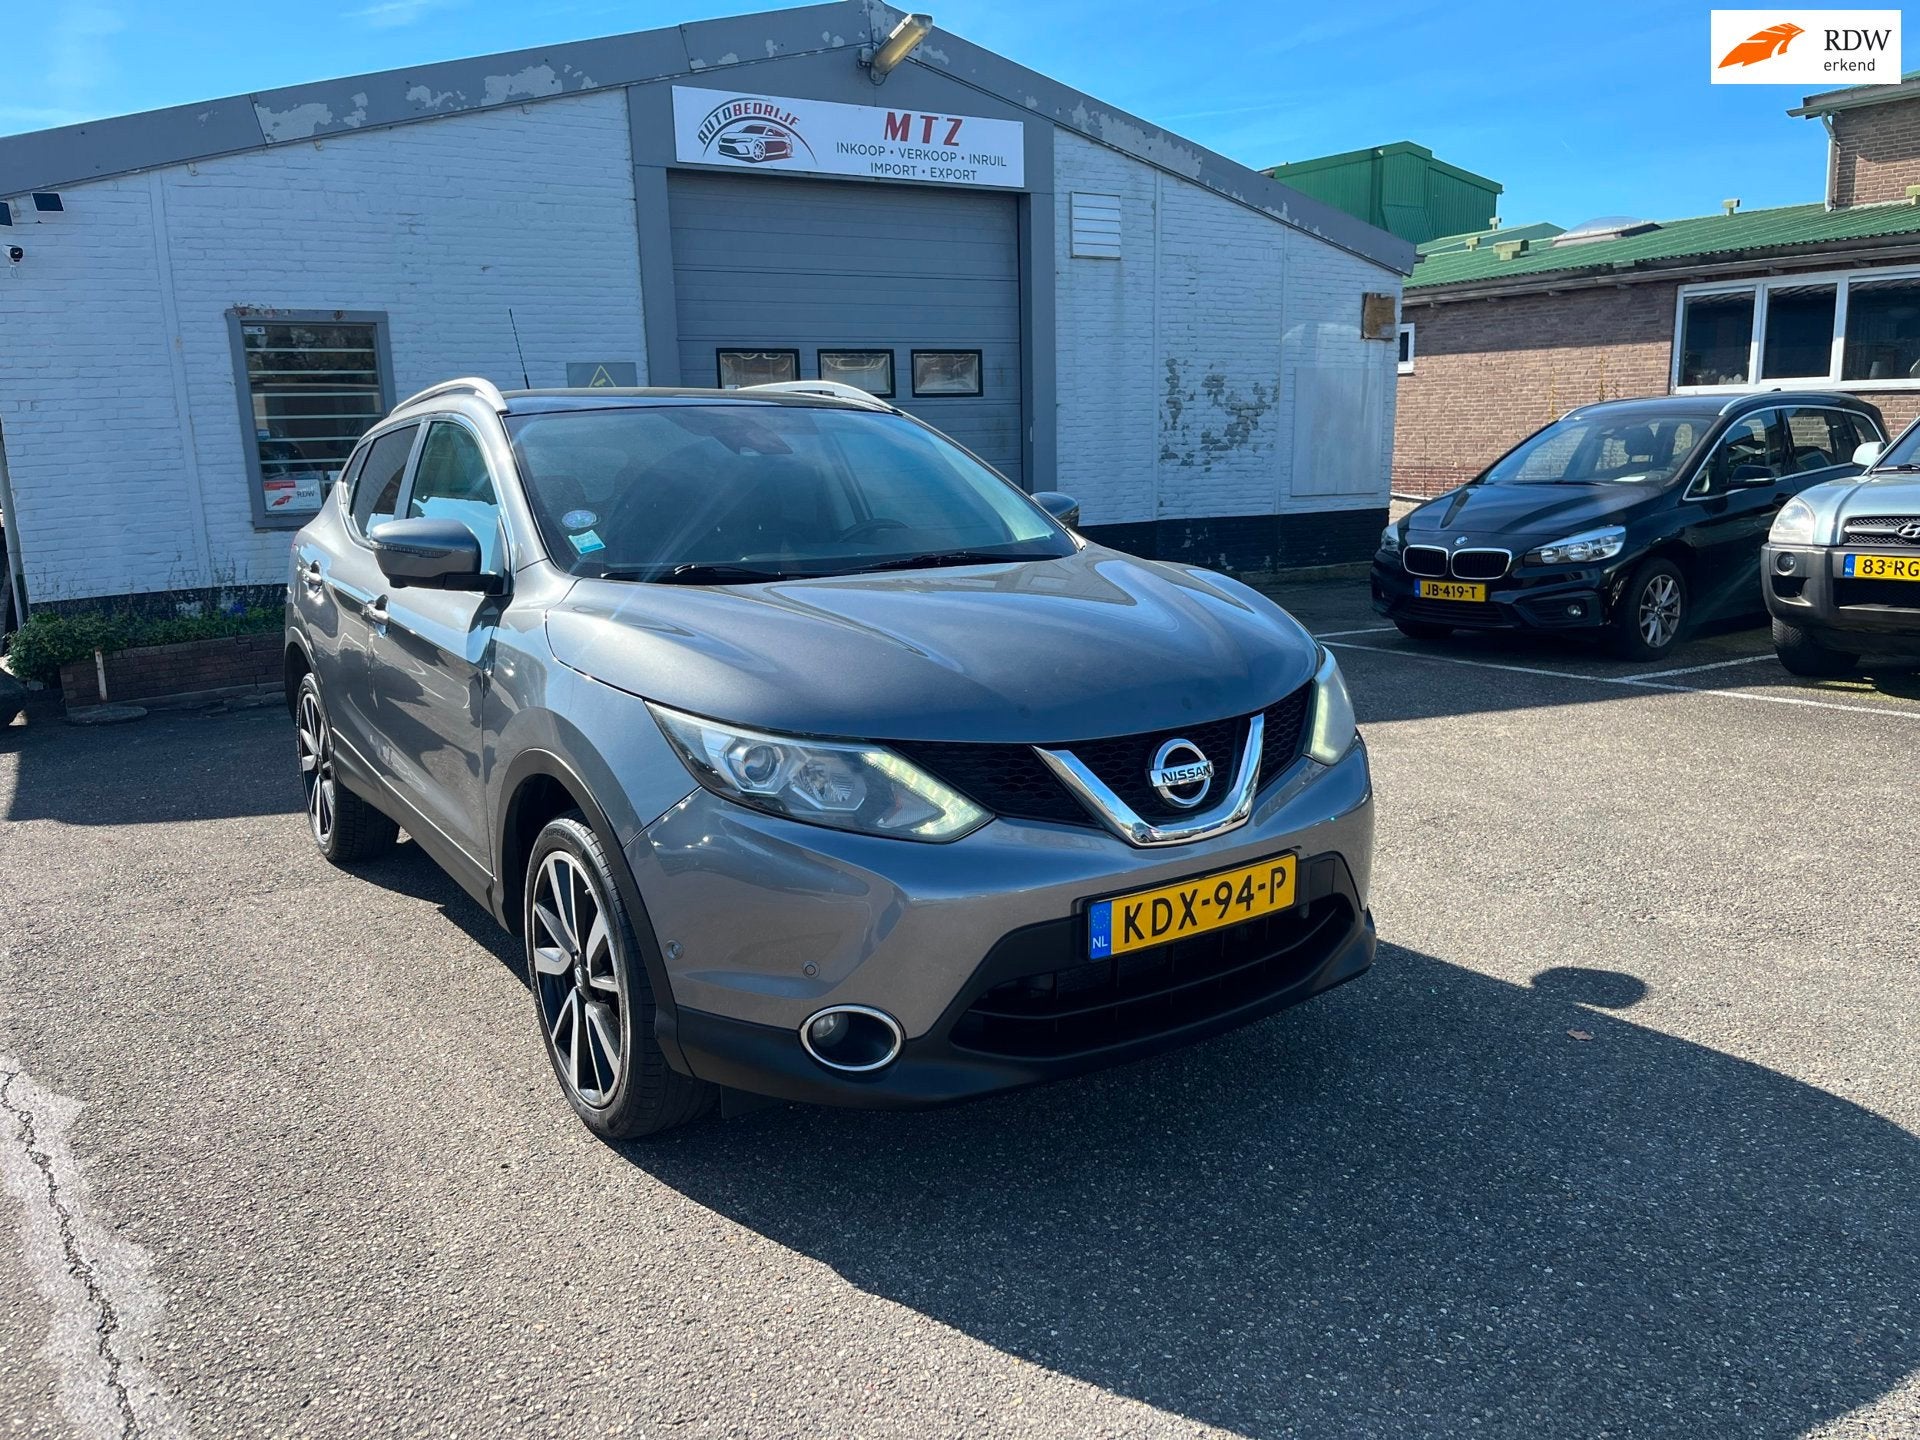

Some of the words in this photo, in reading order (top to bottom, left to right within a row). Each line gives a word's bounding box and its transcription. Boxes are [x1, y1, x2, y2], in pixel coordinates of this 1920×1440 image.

[697, 102, 801, 145] AUTOBEDRIJF
[883, 111, 963, 147] MTZ
[836, 141, 886, 157] INKOOP
[898, 147, 957, 162] VERKOOP
[969, 153, 1007, 167] INRUIL
[870, 162, 917, 177] IMPORT
[930, 167, 977, 181] EXPORT
[1425, 583, 1477, 599] JB-419-T
[1161, 762, 1211, 783] NISSAN
[1092, 935, 1108, 949] NL
[1124, 866, 1287, 944] KDX-94-P
